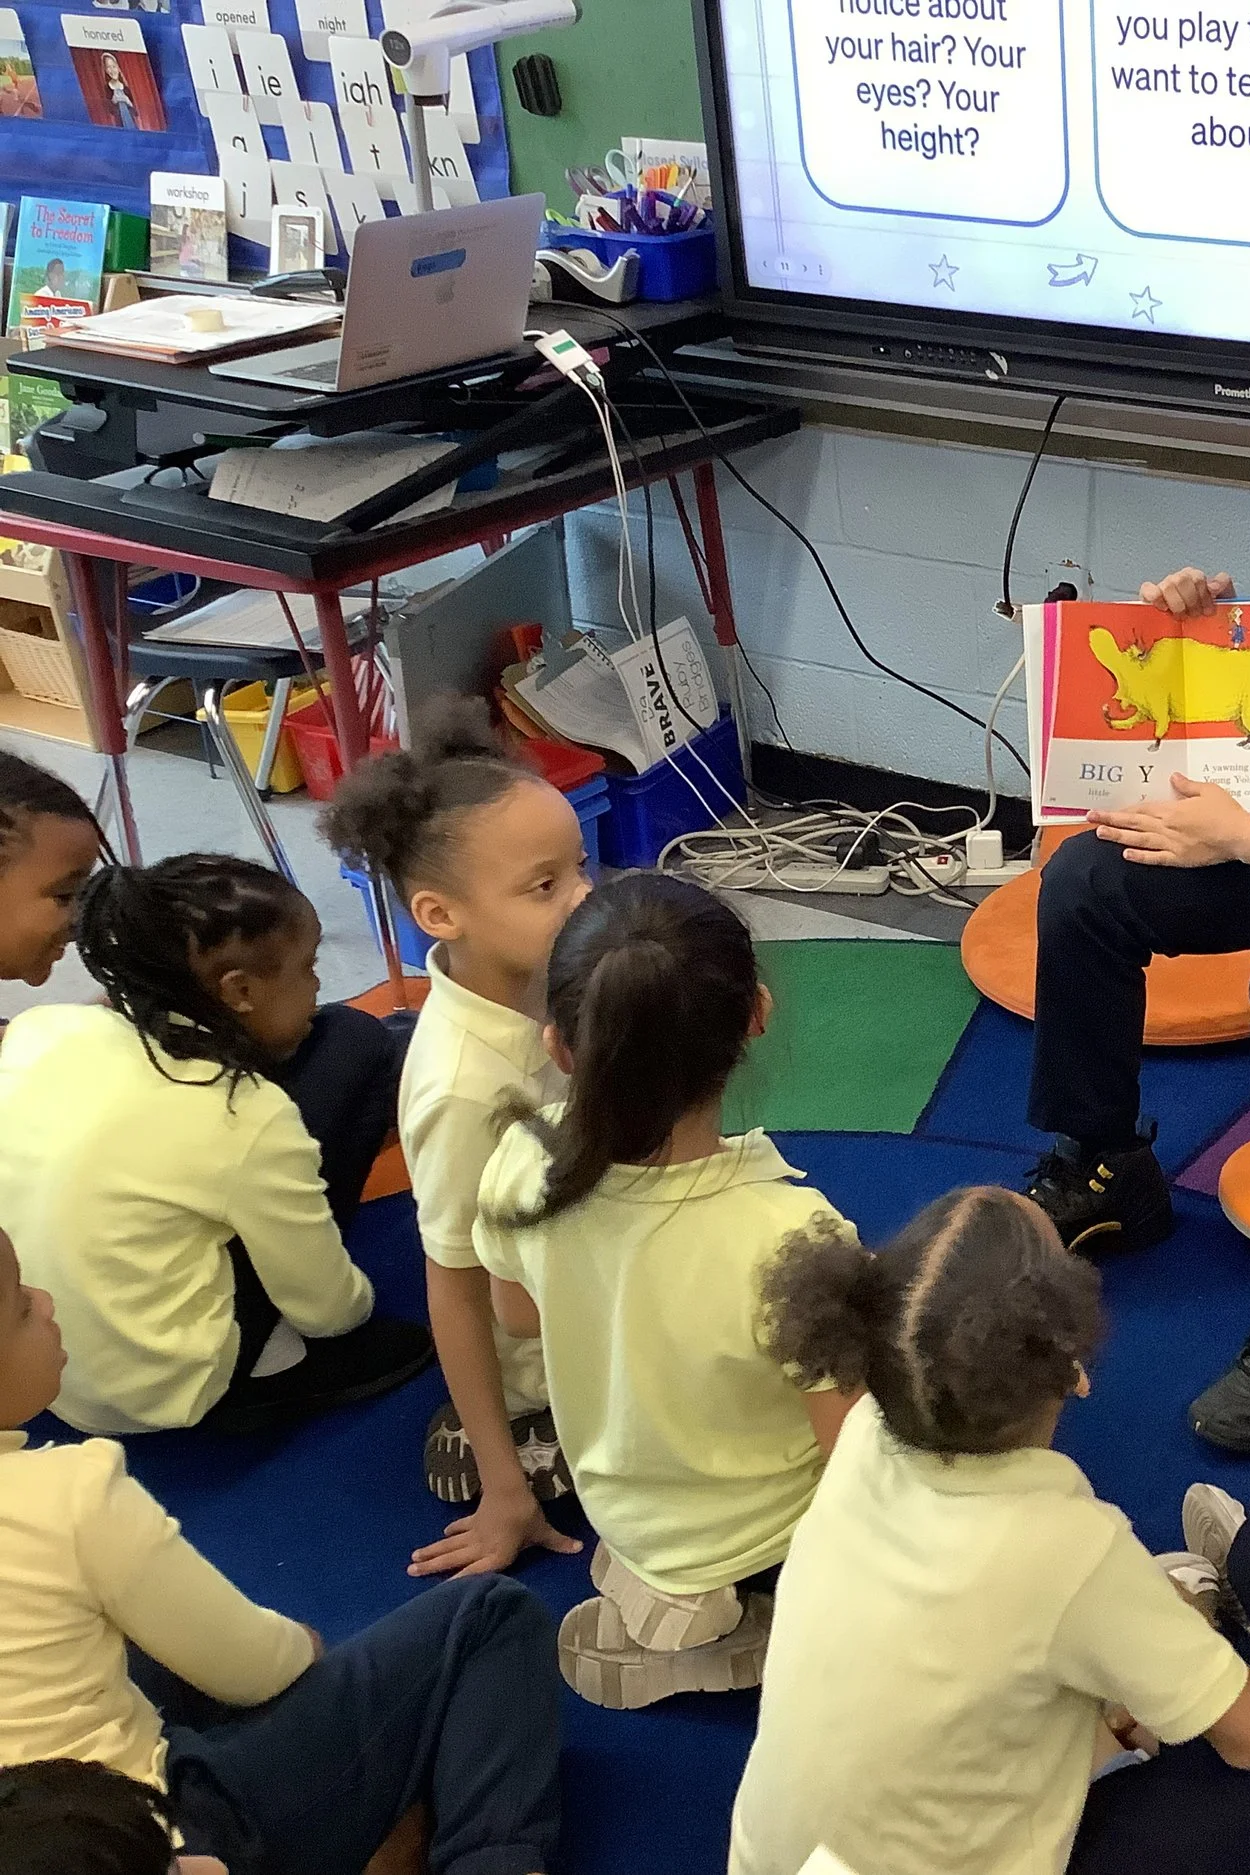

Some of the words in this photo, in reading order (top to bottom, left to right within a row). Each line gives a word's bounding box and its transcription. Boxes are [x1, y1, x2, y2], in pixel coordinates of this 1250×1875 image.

[216, 10, 256, 25] opened
[318, 16, 346, 34] night
[82, 26, 124, 42] honored
[1116, 15, 1168, 45] you
[1179, 11, 1239, 50] play
[825, 34, 883, 65] your
[891, 32, 957, 65] hair?
[963, 36, 1027, 69] Your
[258, 65, 282, 96] ie
[1112, 64, 1181, 94] want
[1189, 65, 1218, 95] to
[857, 79, 931, 111] eyes?
[938, 80, 1000, 113] Your
[882, 121, 980, 160] height?
[166, 185, 209, 203] workshop
[36, 204, 55, 224] The
[58, 207, 95, 227] Secret
[31, 222, 42, 238] to
[45, 223, 94, 243] Freedom
[673, 661, 695, 710] Ruby
[682, 641, 710, 713] Bridges
[640, 662, 676, 748] BRAVE
[1079, 763, 1123, 783] BIG
[1138, 765, 1154, 783] Y
[1203, 764, 1210, 772] A
[1212, 763, 1249, 774] yawning
[1088, 787, 1111, 797] little
[1203, 776, 1231, 785] Young
